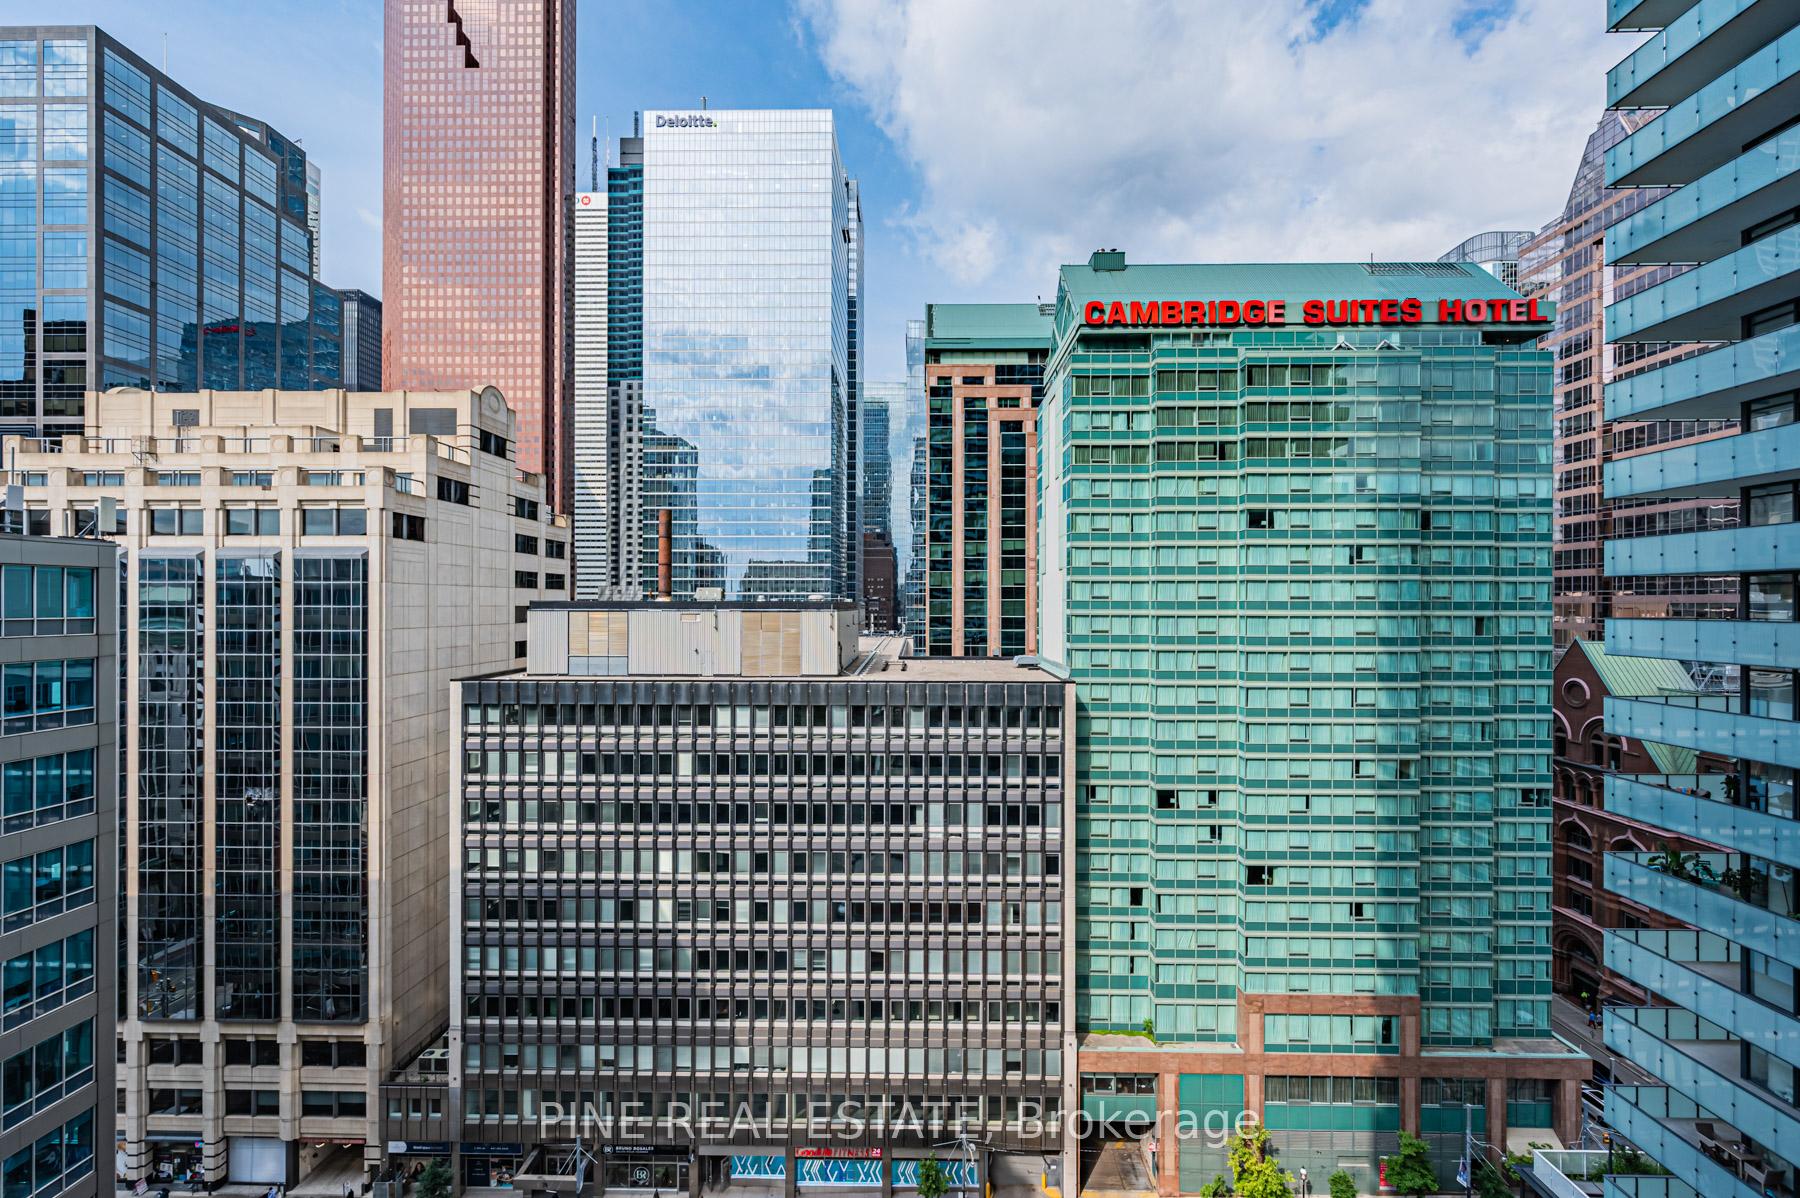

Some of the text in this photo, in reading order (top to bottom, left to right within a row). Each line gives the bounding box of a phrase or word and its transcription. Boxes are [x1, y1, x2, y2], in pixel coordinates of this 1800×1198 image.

[1084, 298, 1549, 326] CAMBRIDGE SUITES HOTEL
